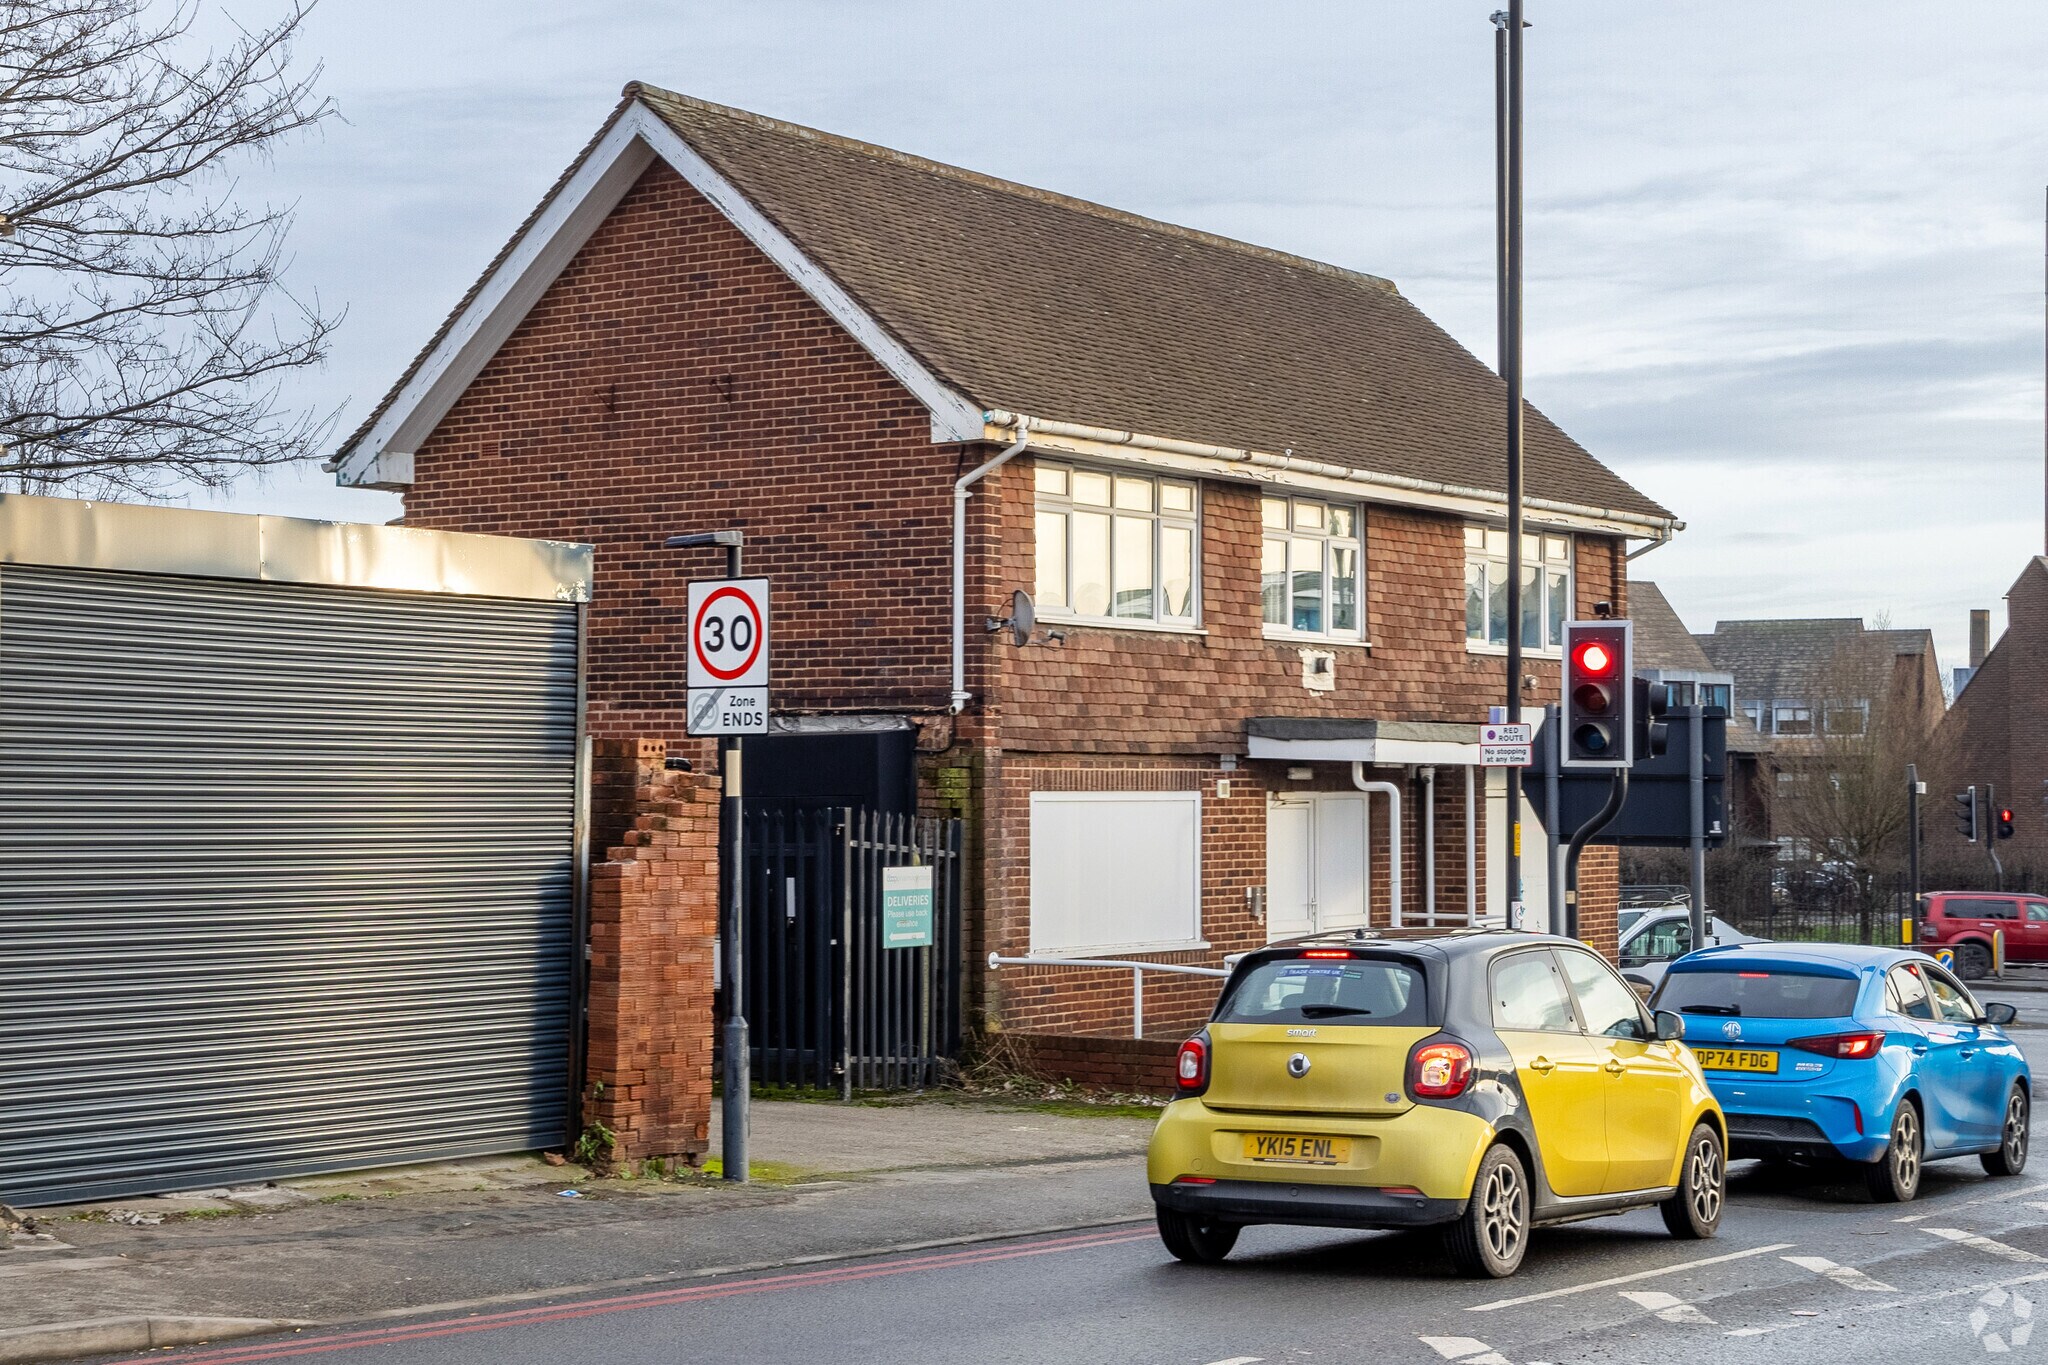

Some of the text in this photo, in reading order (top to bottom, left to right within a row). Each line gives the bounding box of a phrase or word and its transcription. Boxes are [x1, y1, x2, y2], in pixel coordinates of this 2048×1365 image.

[704, 615, 752, 652] 30
[730, 695, 756, 707] Zone
[723, 711, 763, 727] ENDS
[1497, 748, 1527, 756] stopping
[887, 895, 929, 907] DELIVERIES
[1287, 1028, 1317, 1037] smart
[1723, 1022, 1740, 1038] MG
[1697, 1050, 1769, 1068] DP74 FDG
[1256, 1136, 1337, 1159] YK15 ENL
